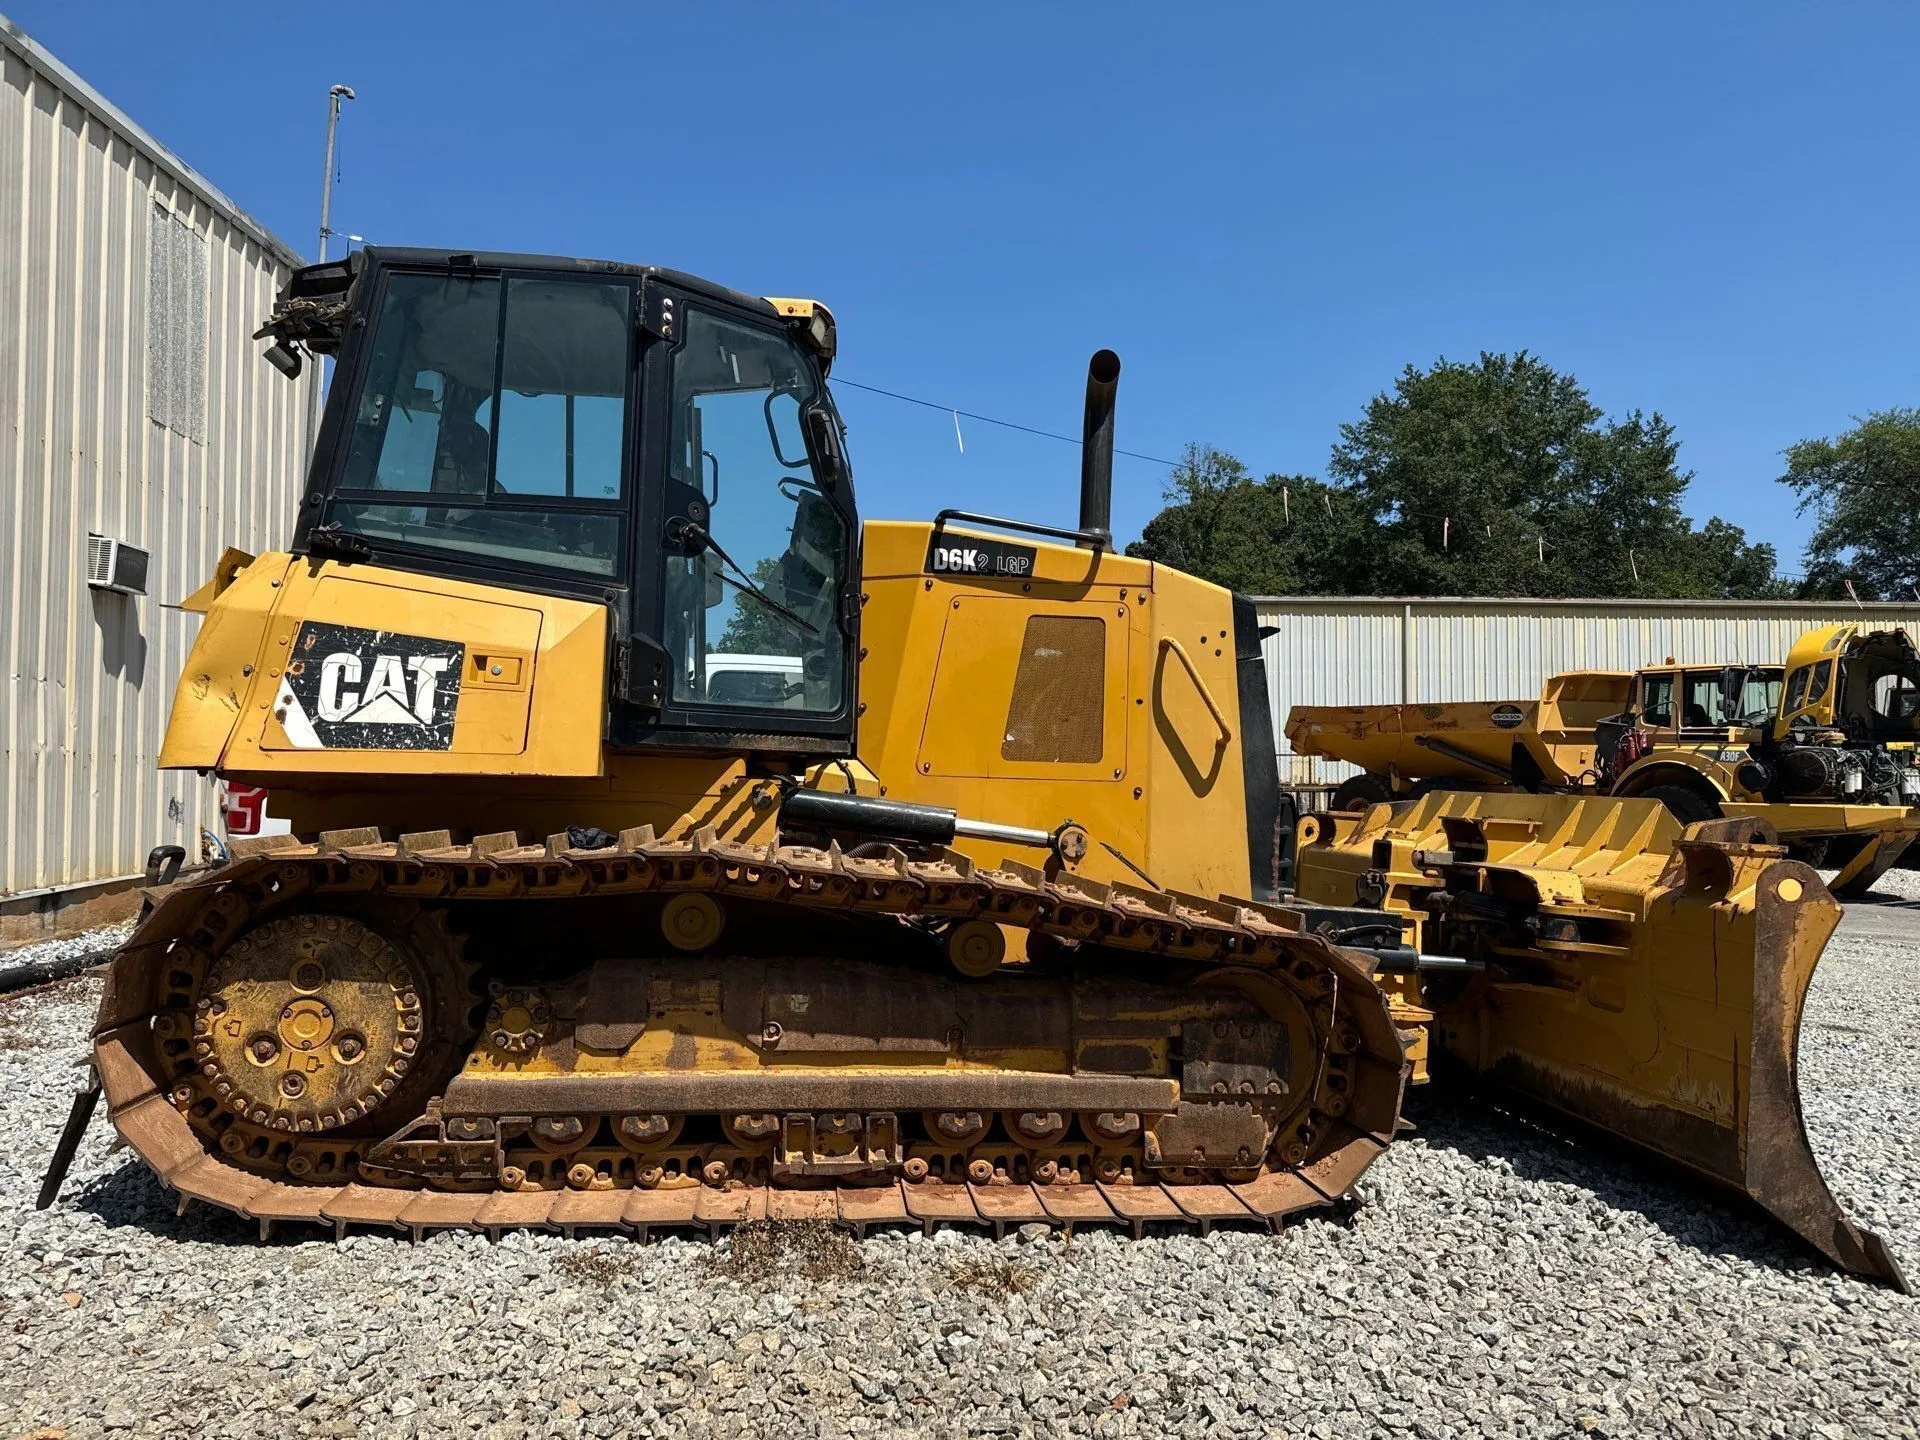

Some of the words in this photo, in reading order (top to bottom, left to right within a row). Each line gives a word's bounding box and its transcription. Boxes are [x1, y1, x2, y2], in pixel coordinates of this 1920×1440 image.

[996, 556, 1029, 574] LGP
[317, 652, 448, 725] CAT
[1720, 751, 1740, 762] A30F
